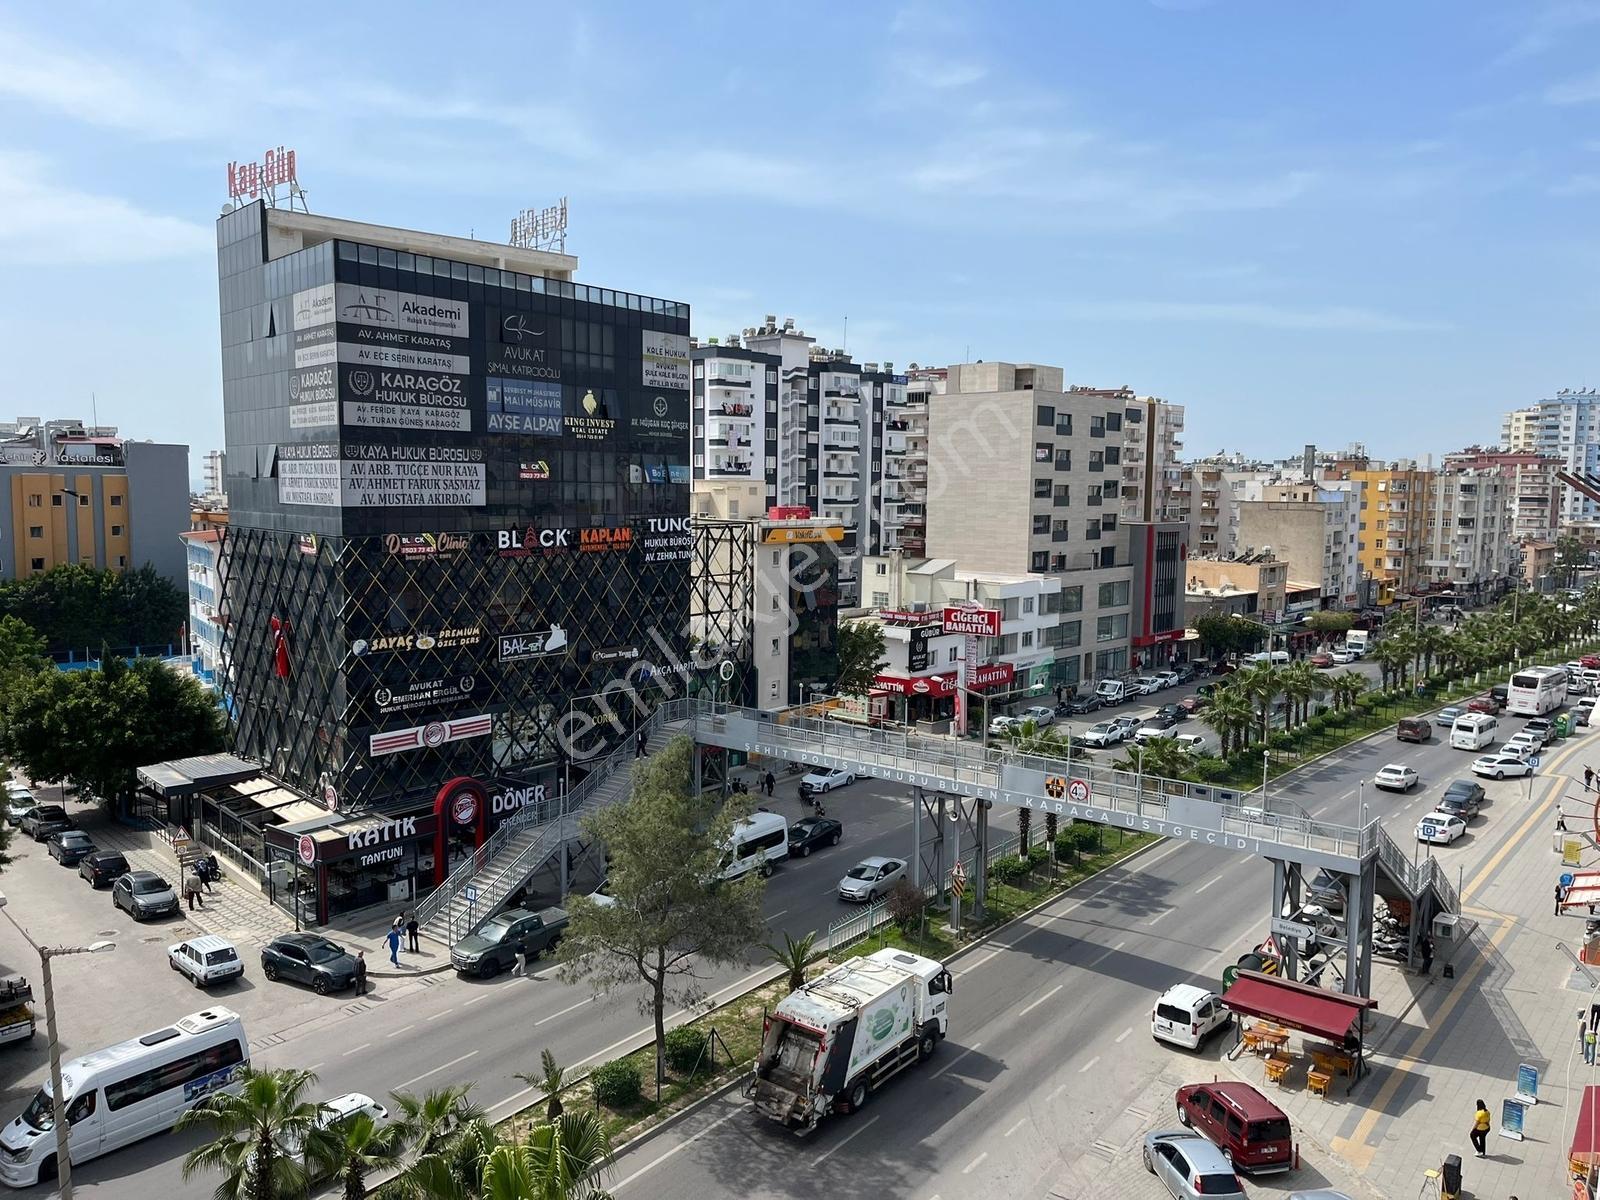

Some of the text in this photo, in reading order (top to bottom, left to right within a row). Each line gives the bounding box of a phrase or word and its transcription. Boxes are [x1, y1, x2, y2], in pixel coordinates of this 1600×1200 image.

[402, 301, 460, 320] Akademi
[358, 328, 452, 349] AV. AHMET KARATAŞ
[358, 350, 452, 367] AV. ECE SERİN KARATAŞ
[504, 346, 544, 362] AVUKAT
[301, 367, 332, 388] KARAGÖZ
[381, 373, 461, 393] KARAGÖZ
[376, 390, 467, 408] HUKUK BÜROSU
[370, 406, 396, 414] FERİDE
[401, 408, 420, 416] KAYA
[425, 408, 460, 418] KARAGÖZ
[371, 417, 397, 425] TURAN
[425, 419, 460, 428] KARAGÖZ
[488, 414, 560, 432] AYŞE ALPAY
[565, 417, 615, 428] KING INVEST
[54, 454, 114, 463] hastanesi
[360, 446, 470, 461] KAYA HUKUK BÜROSU
[350, 463, 478, 478] AV. ARB. TUĞÇE NUR KAYA
[349, 478, 365, 489] AV.
[367, 479, 405, 490] AHMET
[408, 479, 440, 490] FARUK
[360, 492, 471, 505] AV. MUSTAFA AKIRDAĞ
[648, 517, 692, 534] TUNÇ
[438, 532, 468, 552] Clinic
[580, 528, 630, 542] KAPLAN
[644, 538, 668, 548] HUKUK
[645, 554, 656, 562] AV.
[657, 551, 678, 561] ZEHRA
[951, 612, 988, 624] CİĞERCİ
[946, 622, 993, 634] BAHATTİN
[371, 635, 413, 651] SAYAÇ
[438, 637, 480, 648] ÖZEL DERS
[977, 668, 1008, 684] AHATTİN
[409, 680, 443, 691] AVUKAT
[432, 686, 459, 697] ERGÜL
[493, 785, 545, 814] DÖNER
[859, 765, 928, 785] MEMURU
[1026, 798, 1109, 822] KARACA
[349, 816, 416, 850] KATIK
[360, 846, 403, 866] TANTUNİ
